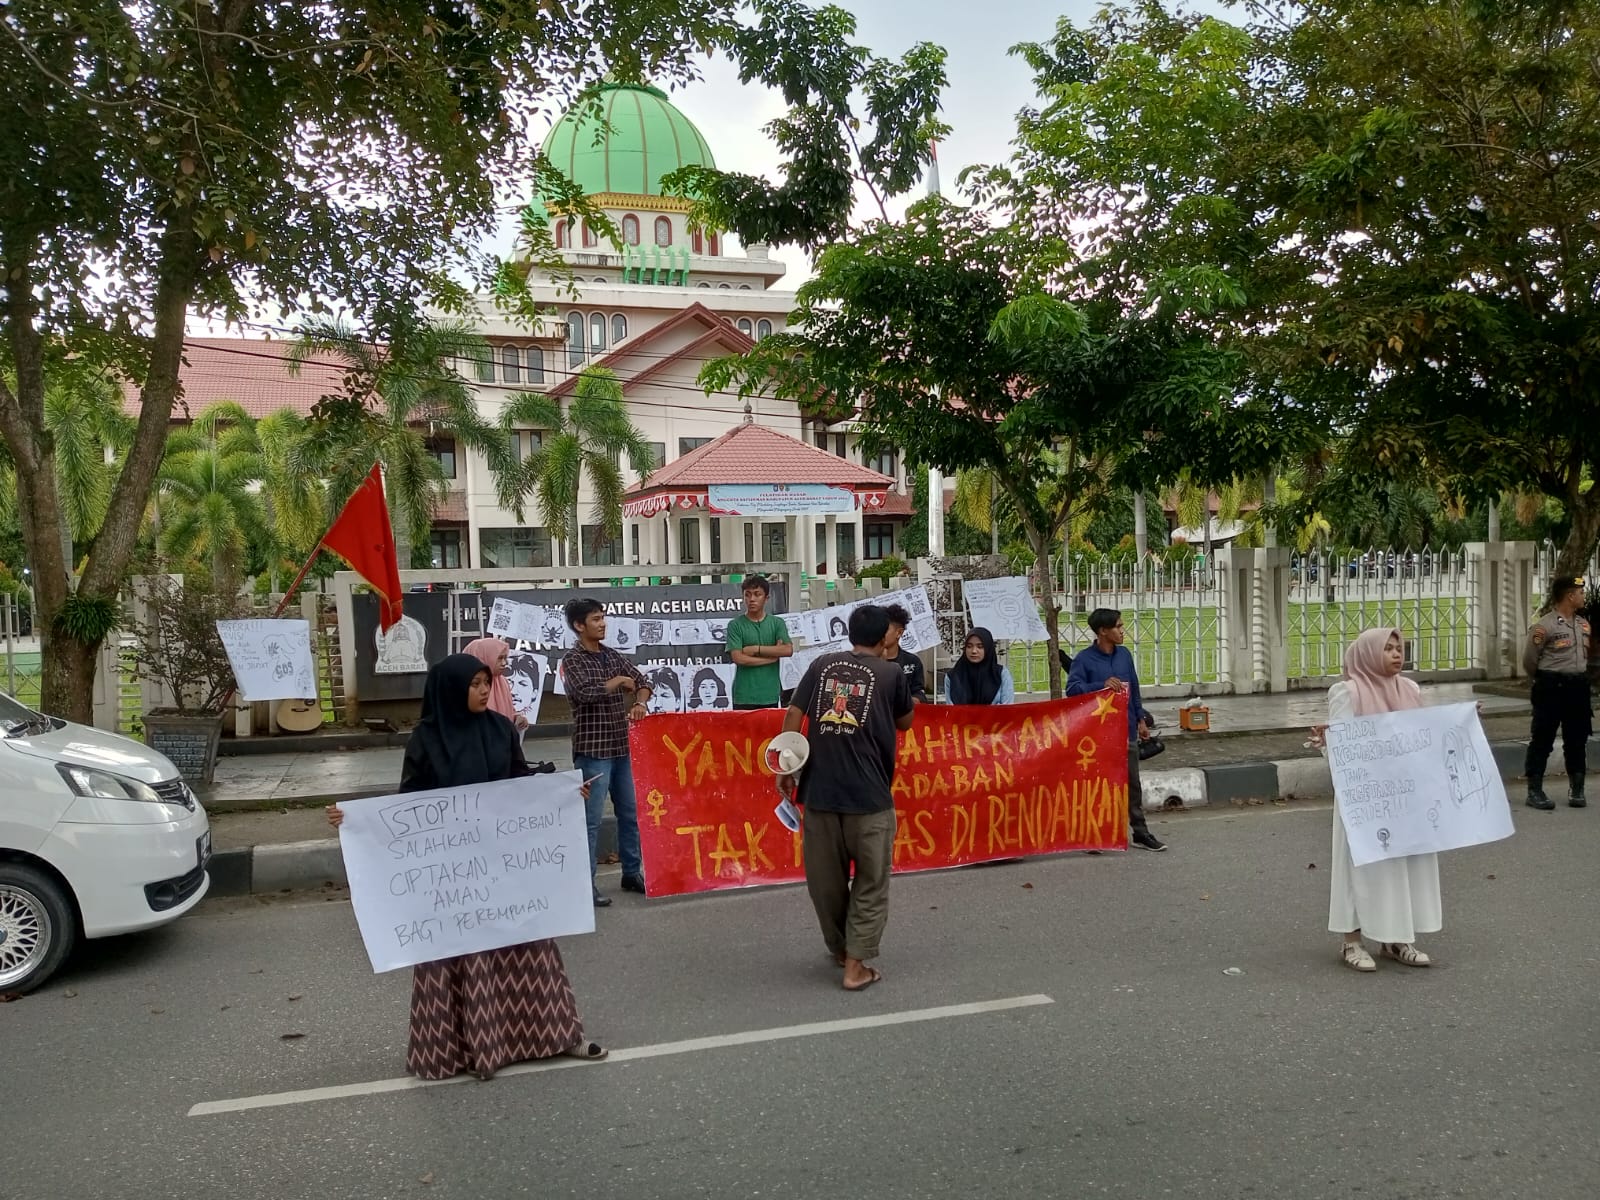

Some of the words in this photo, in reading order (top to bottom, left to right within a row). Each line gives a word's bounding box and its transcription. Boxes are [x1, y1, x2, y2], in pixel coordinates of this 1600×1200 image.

[651, 600, 692, 614] ACEH
[695, 598, 743, 612] BARAT
[376, 664, 398, 672] ACEH
[399, 663, 425, 671] BARAT
[898, 712, 1069, 768] AHIRKAN
[387, 828, 481, 860] SALAHKAN
[496, 807, 563, 838] KORBAN!
[391, 791, 481, 837] STOP!!!
[675, 821, 776, 881] TAK
[952, 800, 977, 859] DI
[987, 775, 1129, 855] RENDAHKAN
[389, 855, 489, 897] CIPTAKAN
[502, 844, 568, 873] RUANG
[455, 897, 550, 937] PEREMPUAN
